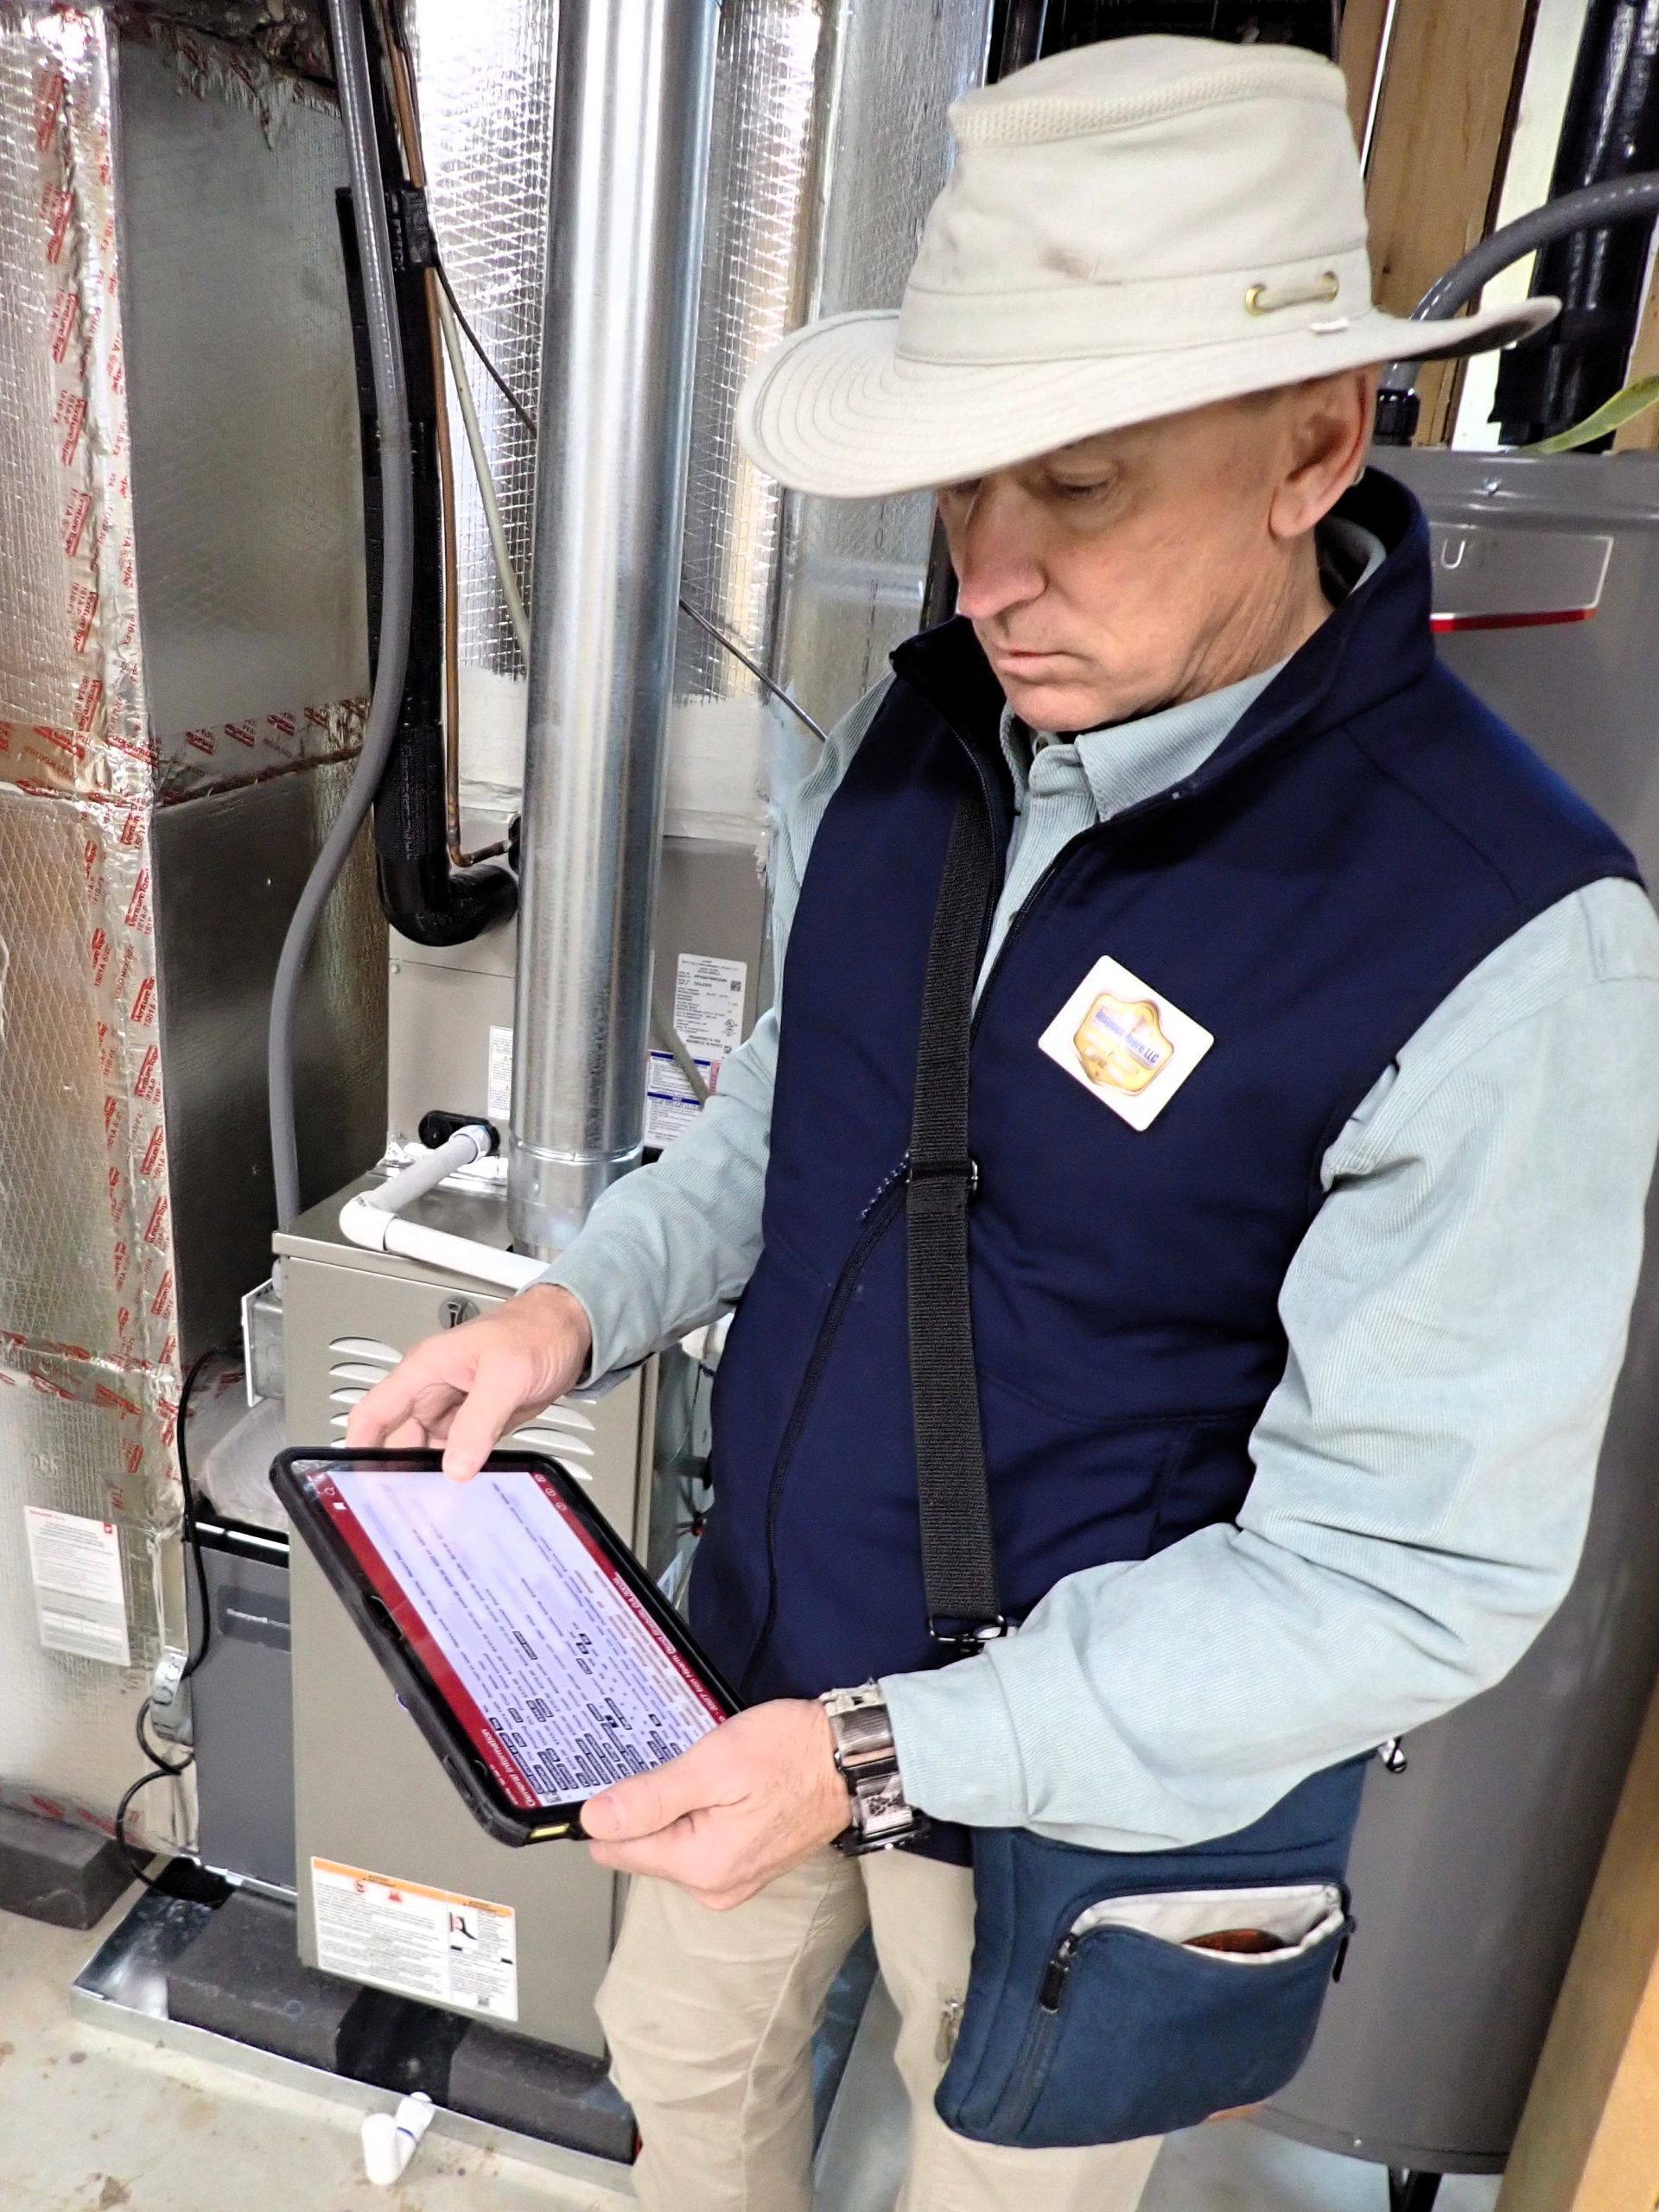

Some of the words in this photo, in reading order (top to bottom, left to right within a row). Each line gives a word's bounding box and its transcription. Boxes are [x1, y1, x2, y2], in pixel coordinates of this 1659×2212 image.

[1142, 1047, 1160, 1064] LLC
[479, 1728, 516, 1771] Information
[508, 1774, 537, 1806] General
